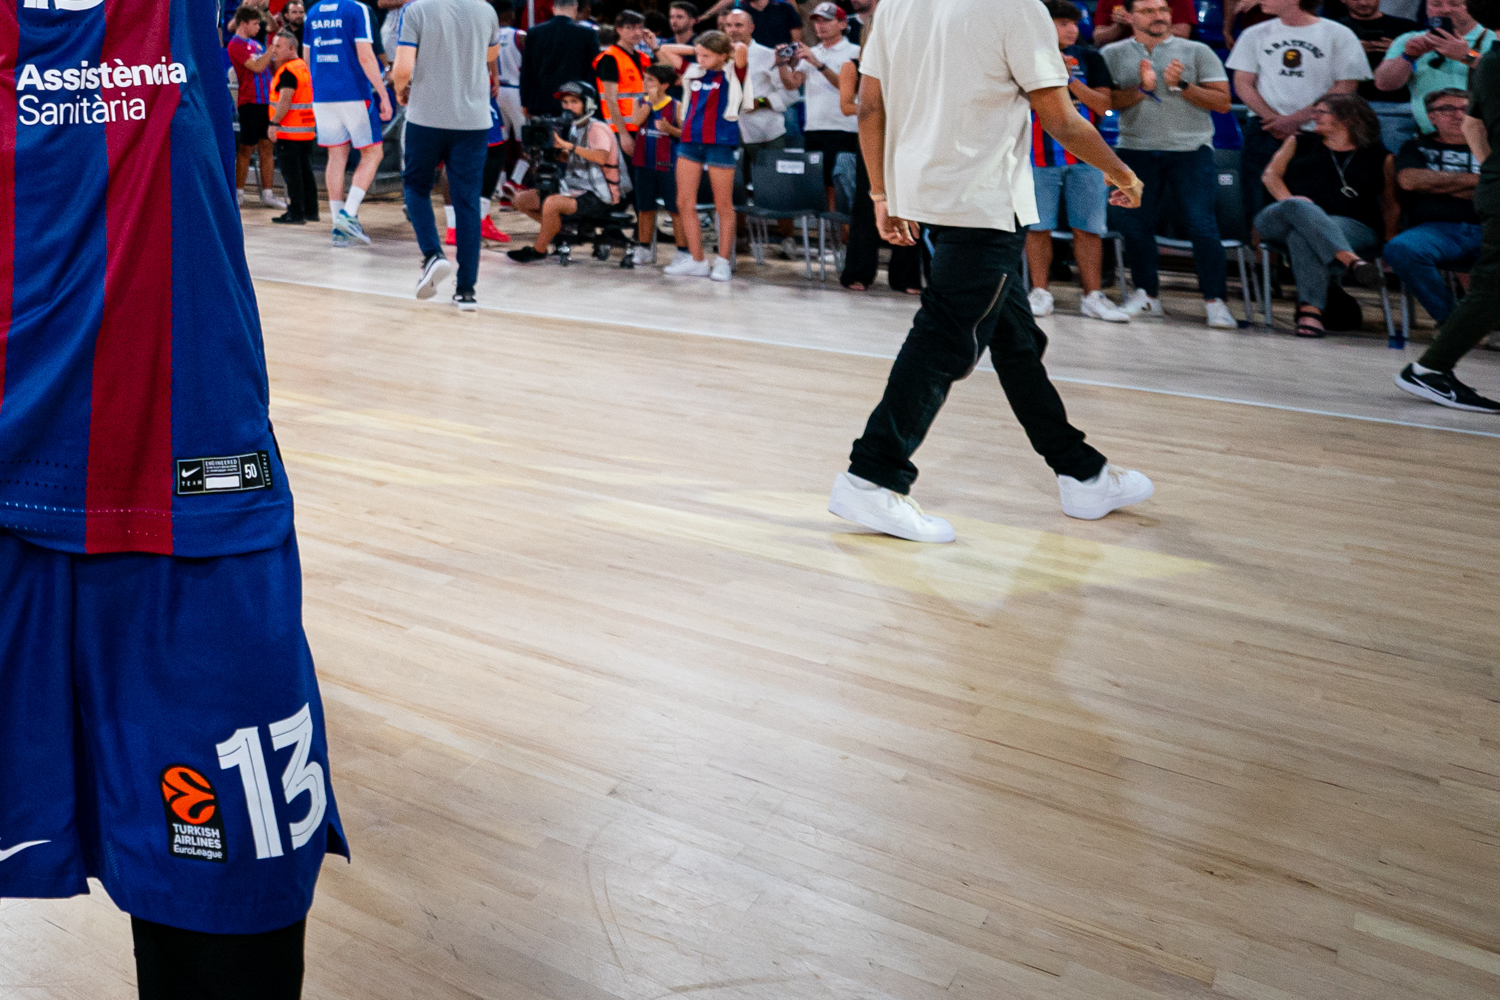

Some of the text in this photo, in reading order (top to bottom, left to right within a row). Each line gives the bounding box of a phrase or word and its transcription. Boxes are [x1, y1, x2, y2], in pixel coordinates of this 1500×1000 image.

[16, 56, 187, 91] Assistència
[19, 91, 146, 126] Sanitària
[244, 463, 257, 479] 50
[215, 702, 327, 860] 13
[172, 822, 220, 839] TURKISH
[173, 833, 222, 849] AIRLINES
[173, 843, 223, 860] EuroLeague
